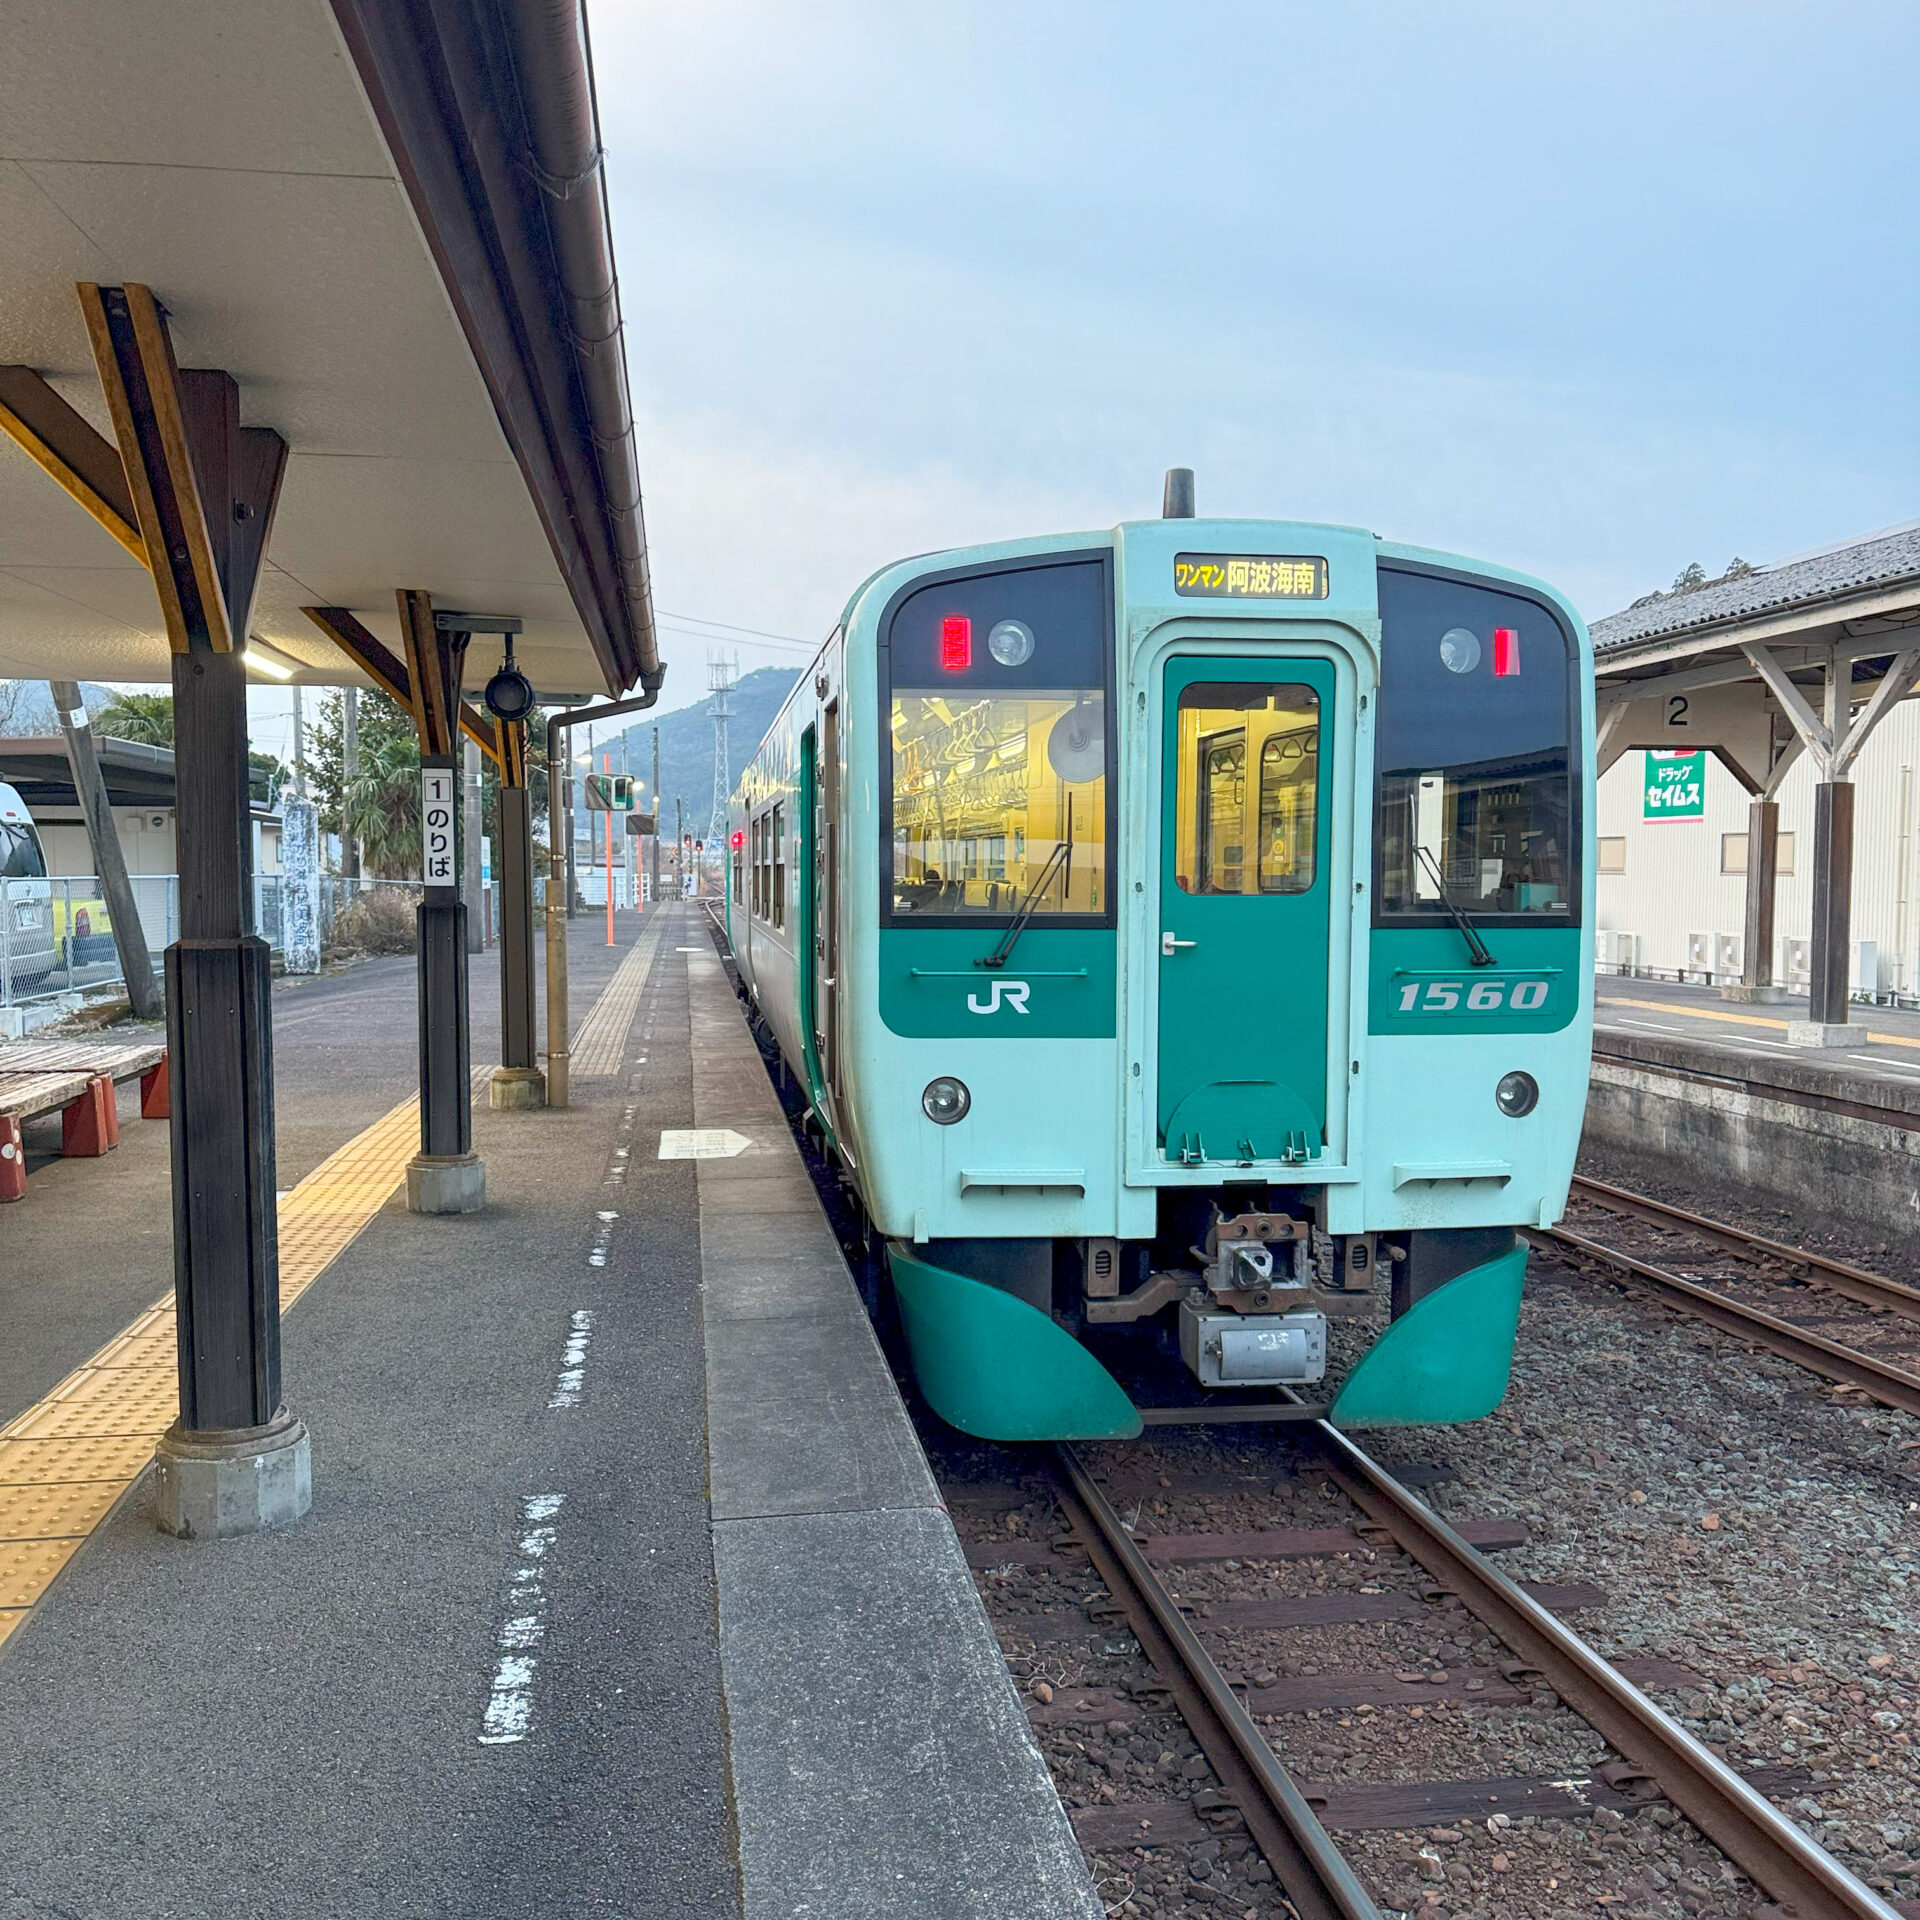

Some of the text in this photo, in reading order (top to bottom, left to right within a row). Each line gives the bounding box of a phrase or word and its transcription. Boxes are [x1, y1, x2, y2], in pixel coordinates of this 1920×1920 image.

[1176, 563, 1226, 588] ワンマン
[1227, 560, 1315, 595] 阿波海南
[1668, 695, 1689, 726] 2
[1658, 764, 1693, 783] ドラッグ
[1648, 783, 1700, 808] セイムス
[967, 980, 1031, 1015] JR
[1398, 981, 1549, 1011] 1560
